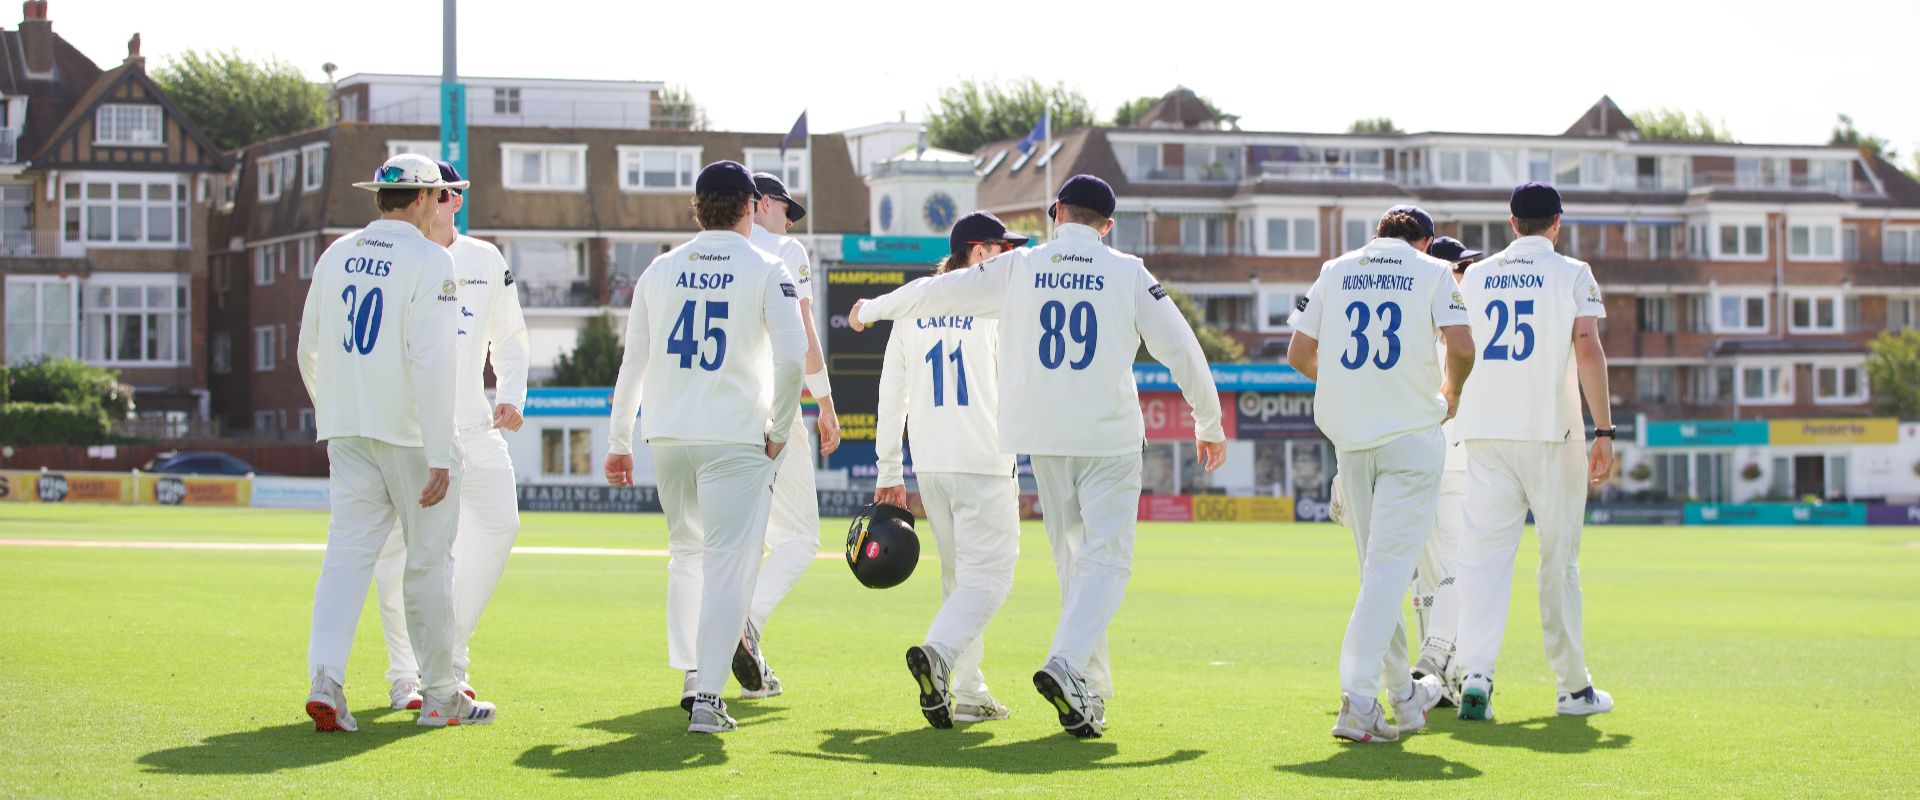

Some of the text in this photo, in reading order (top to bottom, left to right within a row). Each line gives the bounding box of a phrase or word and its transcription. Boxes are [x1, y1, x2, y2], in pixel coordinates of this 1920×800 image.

[365, 239, 394, 249] dafabet
[700, 252, 731, 262] dafabet
[1062, 254, 1093, 264] dafabet
[1370, 257, 1402, 265] dafabet
[345, 257, 392, 277] COLES
[676, 272, 734, 289] ALSOP
[828, 271, 905, 284] HAMPSHIRE
[1034, 272, 1104, 291] HUGHES
[1342, 274, 1414, 292] HUDSON-PRENTICE
[1484, 274, 1544, 289] ROBINSON
[341, 284, 383, 356] 30
[916, 315, 974, 331] CARTER
[667, 299, 729, 371] 45
[1039, 300, 1098, 371] 89
[1340, 301, 1402, 371] 33
[1483, 299, 1535, 361] 25
[925, 339, 969, 407] 11
[1239, 391, 1315, 422] Optim
[608, 487, 655, 501] POST
[821, 492, 865, 506] POST
